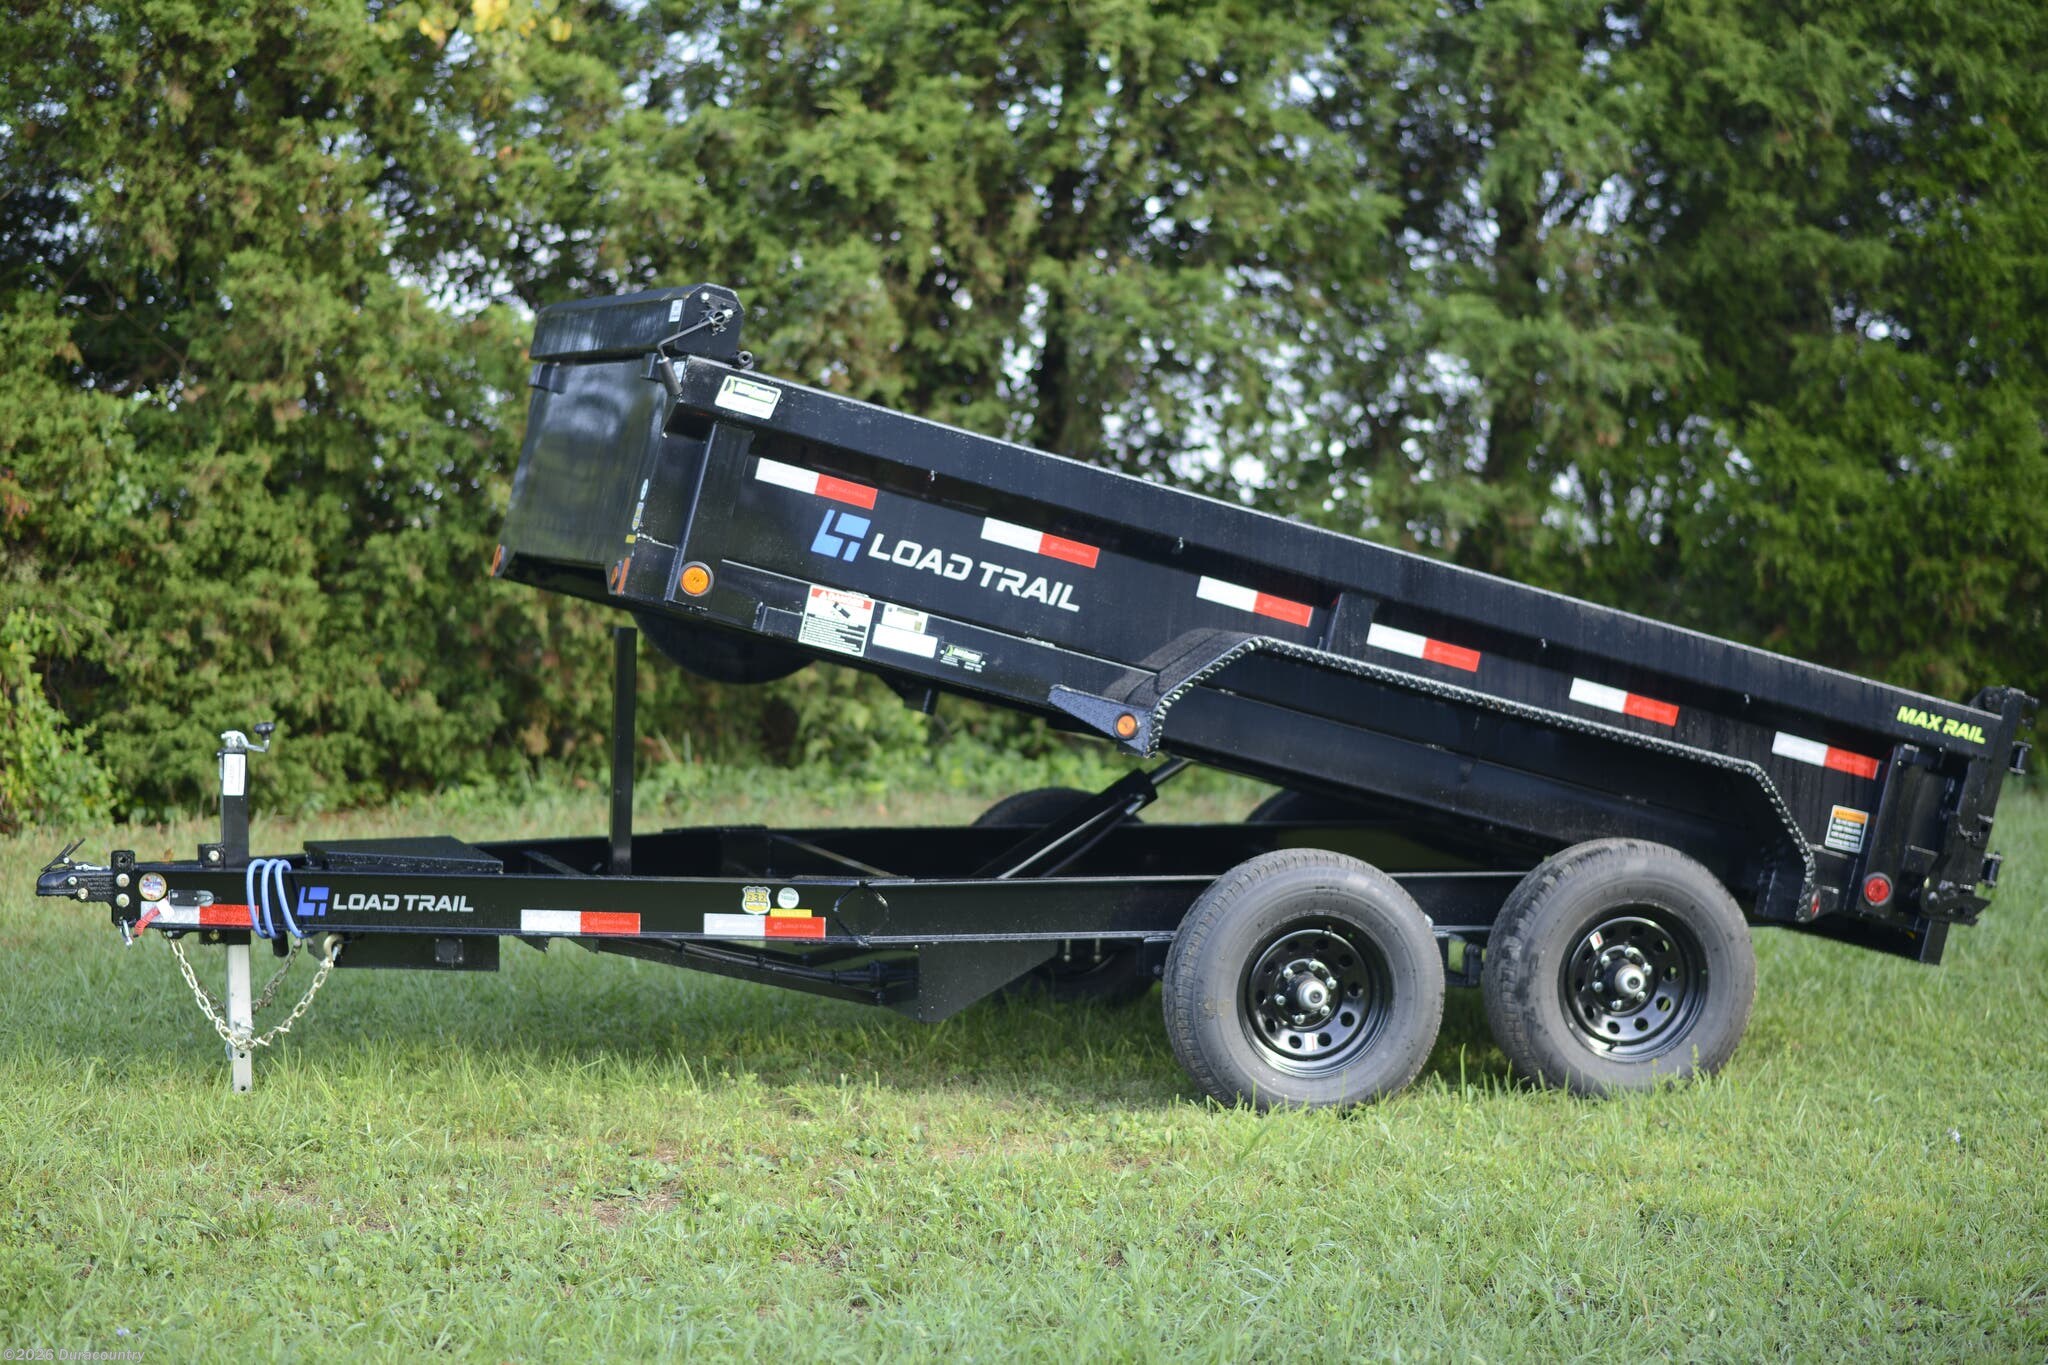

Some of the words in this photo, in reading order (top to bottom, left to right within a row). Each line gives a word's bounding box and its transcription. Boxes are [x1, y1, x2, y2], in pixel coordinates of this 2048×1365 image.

[867, 533, 973, 582] LOAD
[979, 561, 1081, 612] TRAIL
[1896, 705, 1943, 733] MAX
[1942, 717, 1986, 745] RAIL
[332, 893, 399, 910] LOAD
[403, 894, 474, 912] TRAIL
